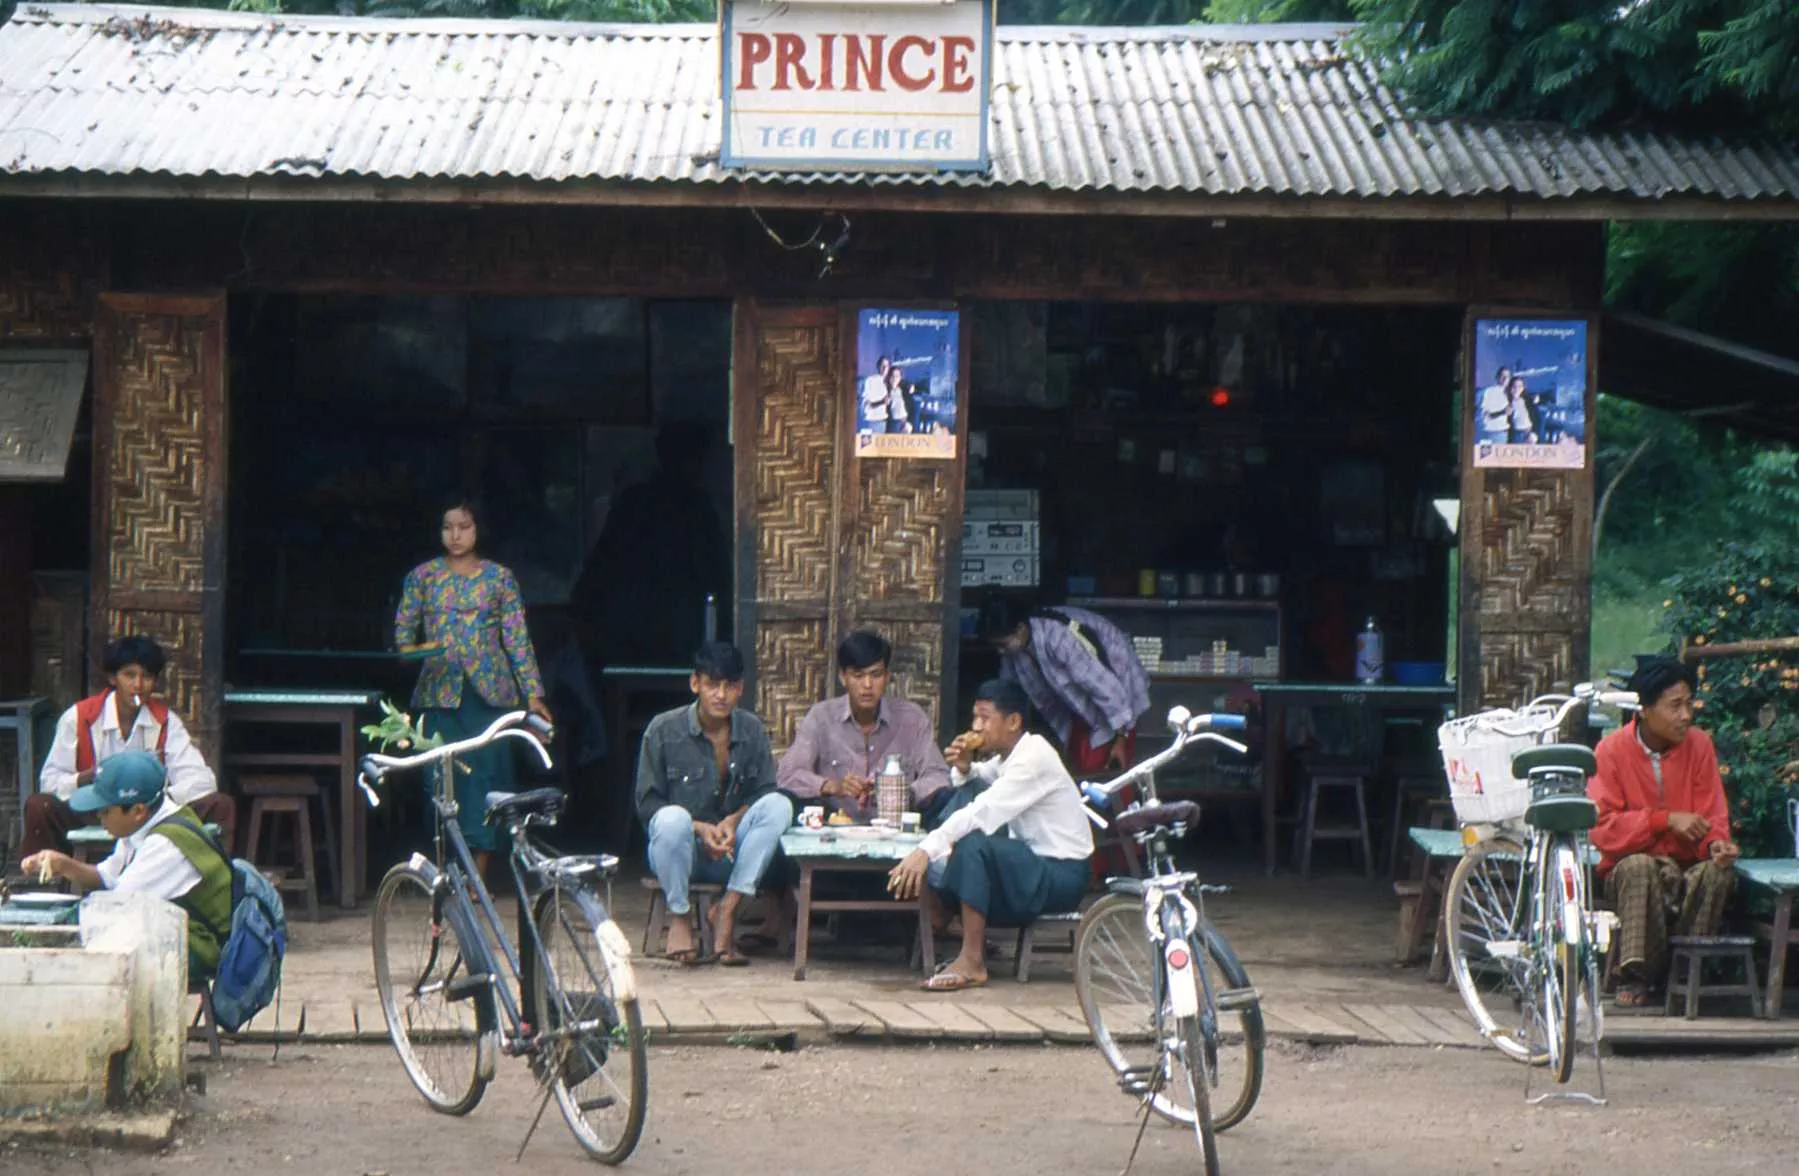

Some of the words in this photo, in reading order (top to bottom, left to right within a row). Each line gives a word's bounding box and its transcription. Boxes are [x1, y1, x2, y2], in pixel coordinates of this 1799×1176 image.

[735, 32, 976, 93] PRINCE
[757, 126, 817, 148] TEA
[831, 127, 953, 150] CENTER
[875, 435, 931, 449] LONDON
[1495, 447, 1557, 459] LONDON
